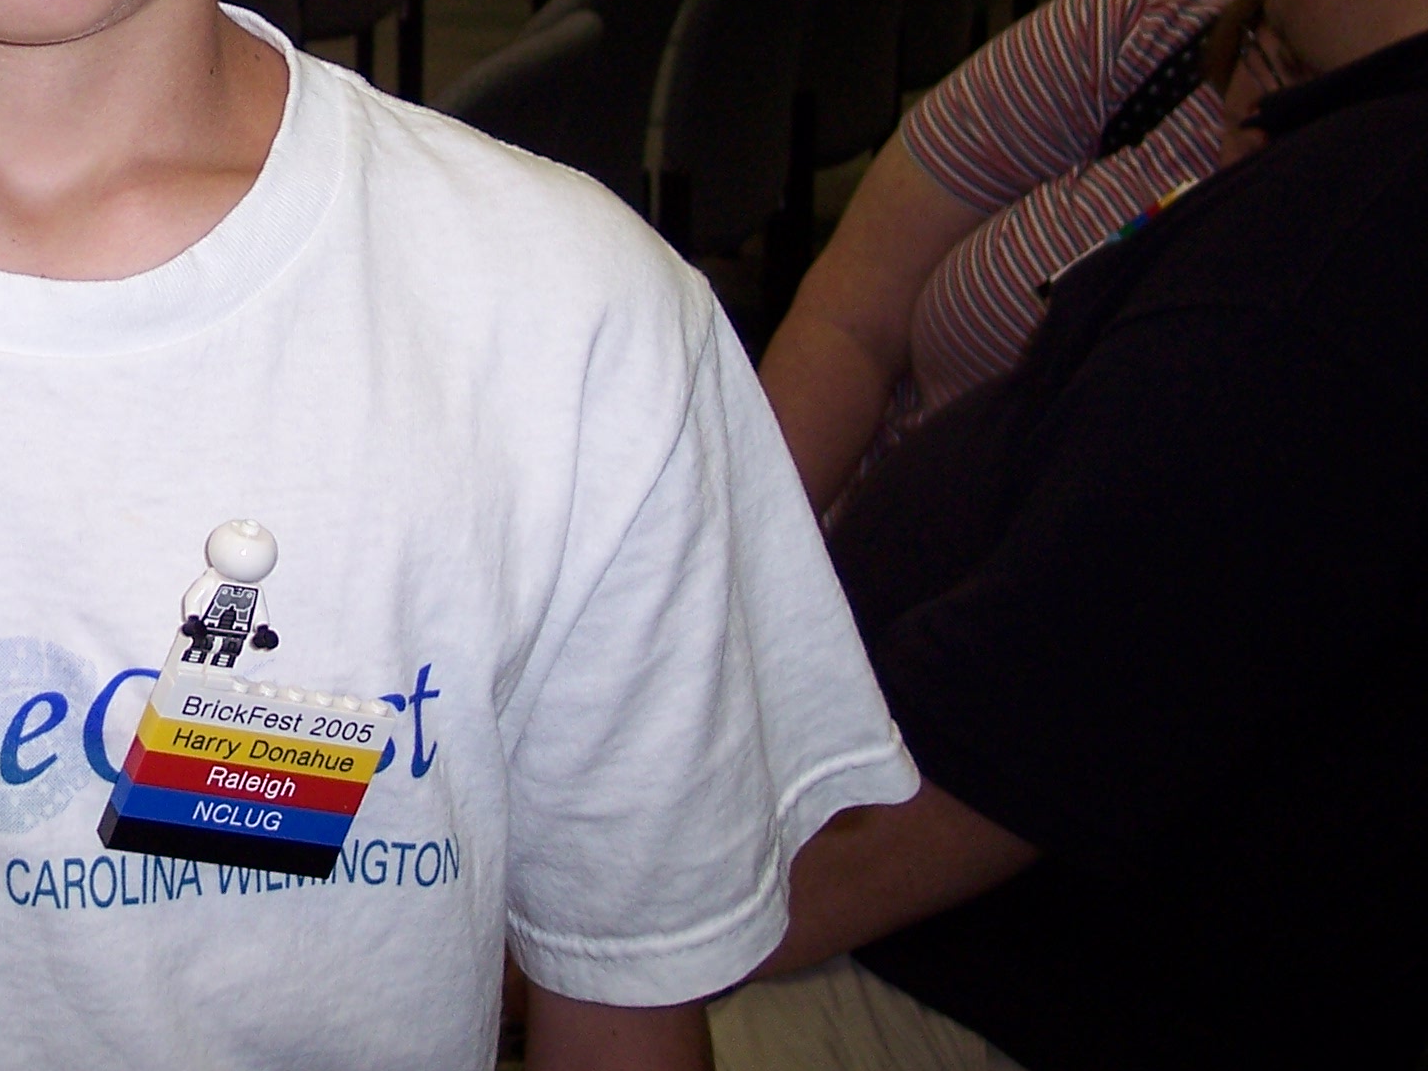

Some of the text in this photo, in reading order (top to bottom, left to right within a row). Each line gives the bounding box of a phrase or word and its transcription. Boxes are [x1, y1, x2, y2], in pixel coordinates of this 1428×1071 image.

[181, 695, 375, 744] BrickFest 2005
[172, 728, 355, 773] Harry Donahue
[207, 765, 296, 798] Raleigh
[192, 800, 283, 831] NCLUG
[5, 854, 203, 909] CAROLINA
